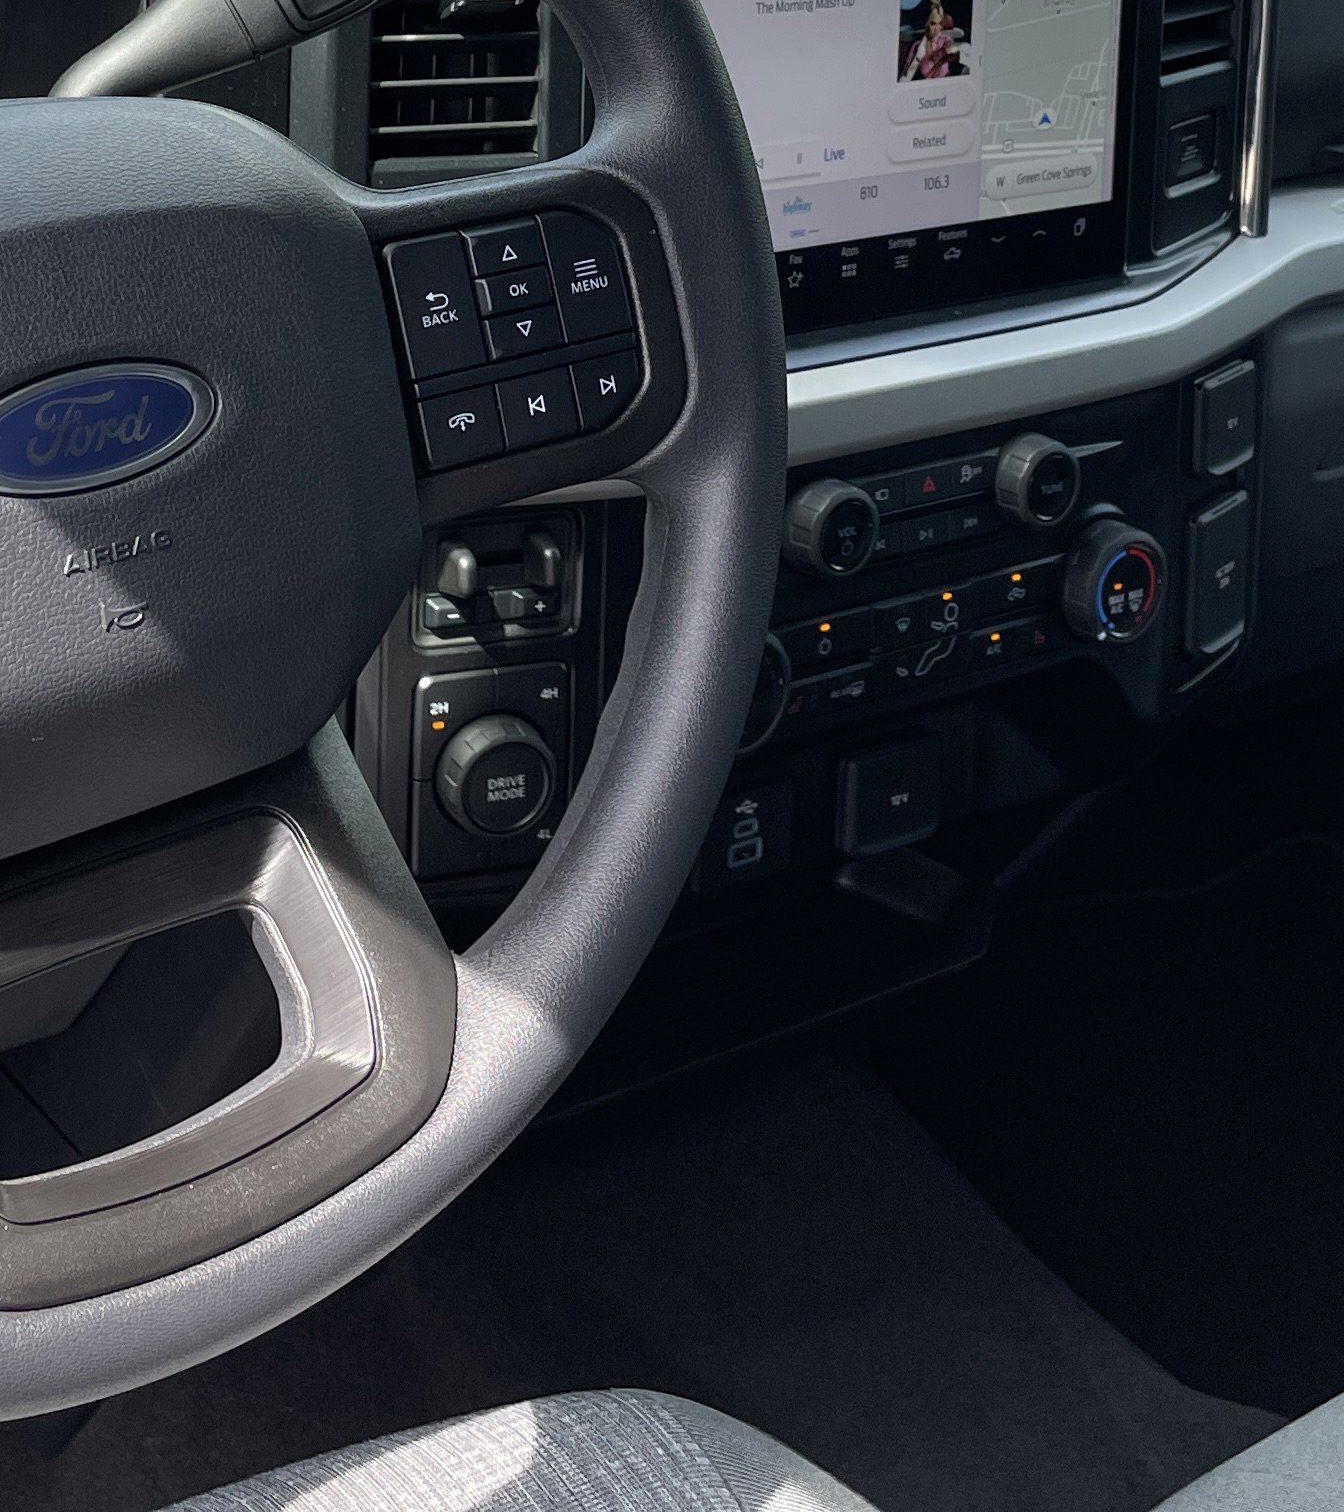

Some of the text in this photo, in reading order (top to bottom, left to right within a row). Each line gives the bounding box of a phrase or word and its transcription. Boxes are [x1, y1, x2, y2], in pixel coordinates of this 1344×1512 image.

[757, 1, 773, 15] The
[919, 96, 946, 110] Sound
[912, 135, 946, 149] Related
[824, 148, 846, 162] Live
[923, 175, 950, 191] 106.3
[996, 165, 1092, 188] W Green Cove Springs
[860, 185, 878, 201] 810
[509, 281, 529, 298] OK
[570, 275, 609, 295] MENU
[421, 309, 459, 330] BACK
[25, 389, 152, 467] Ford
[63, 528, 174, 578] AIRBAG
[540, 687, 559, 700] 4H
[487, 773, 527, 790] DRIVE
[487, 787, 527, 803] MODE
